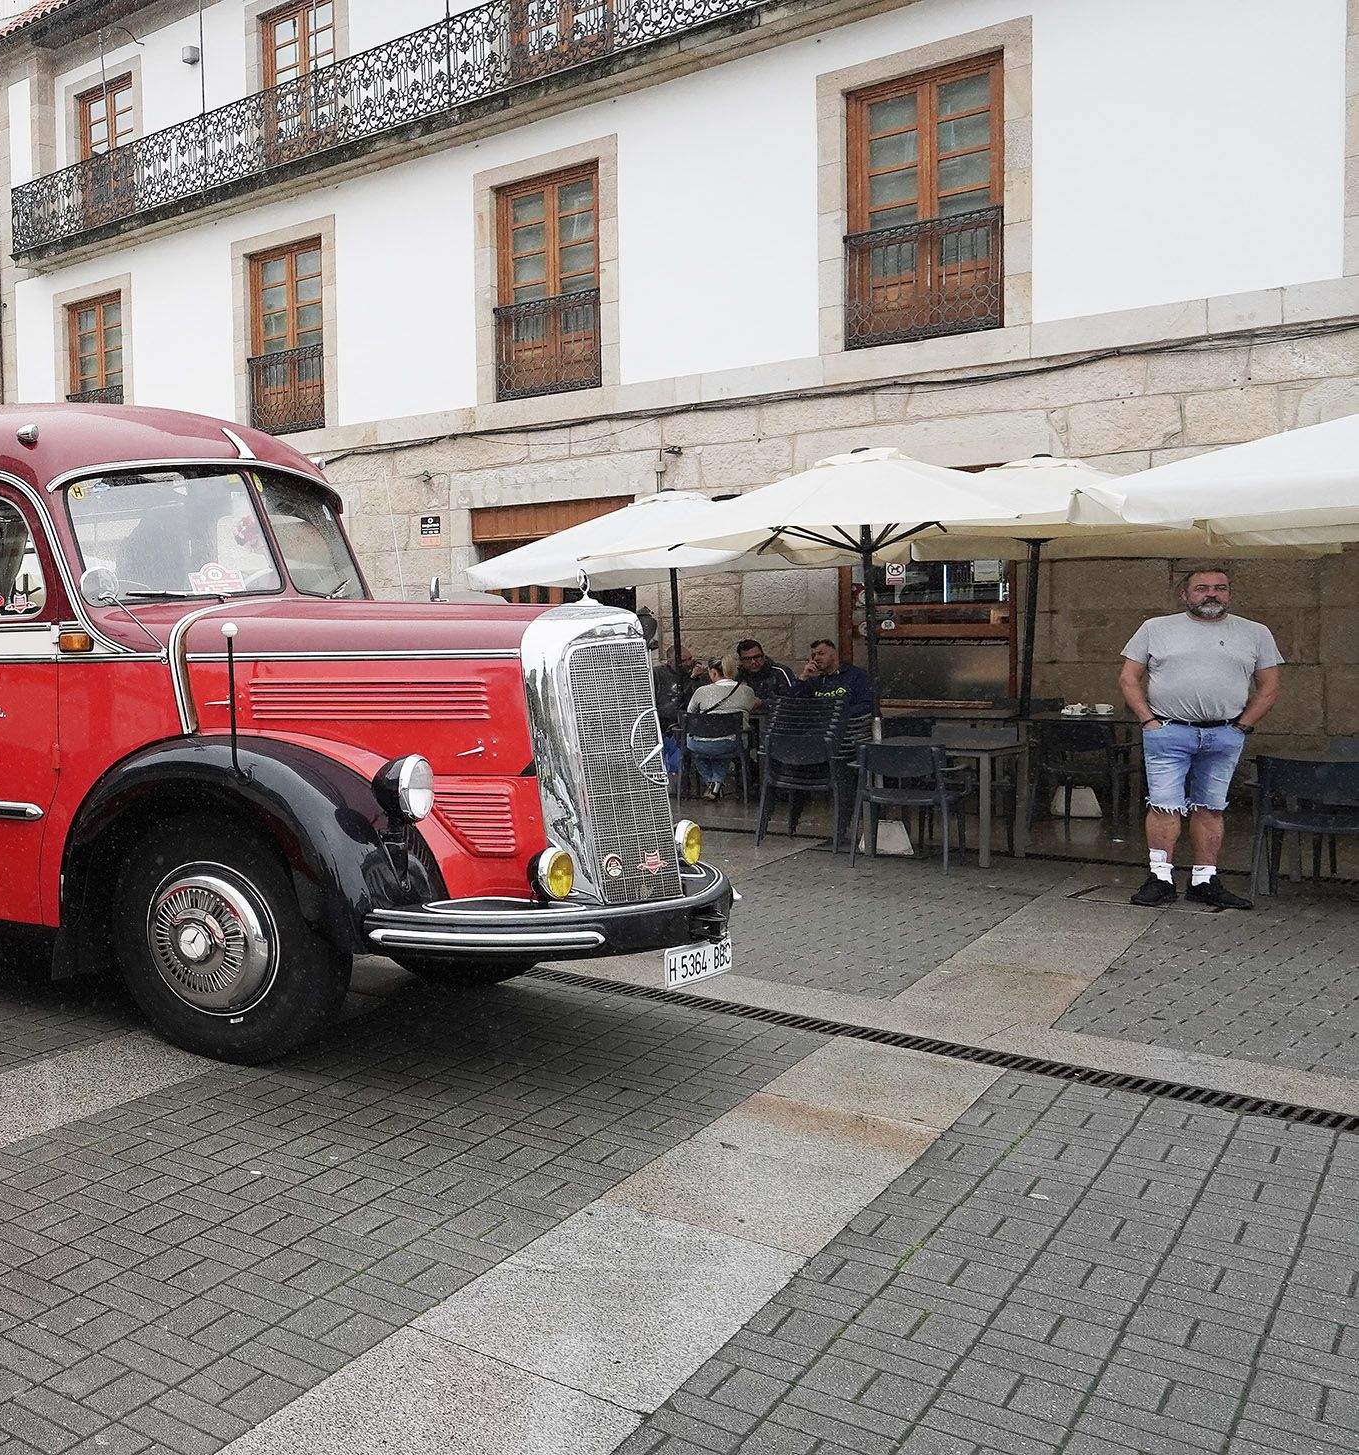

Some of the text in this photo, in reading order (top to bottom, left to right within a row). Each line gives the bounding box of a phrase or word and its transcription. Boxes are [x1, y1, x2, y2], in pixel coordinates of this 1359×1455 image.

[72, 486, 83, 498] H
[669, 957, 677, 982] H
[681, 949, 708, 979] 5364
